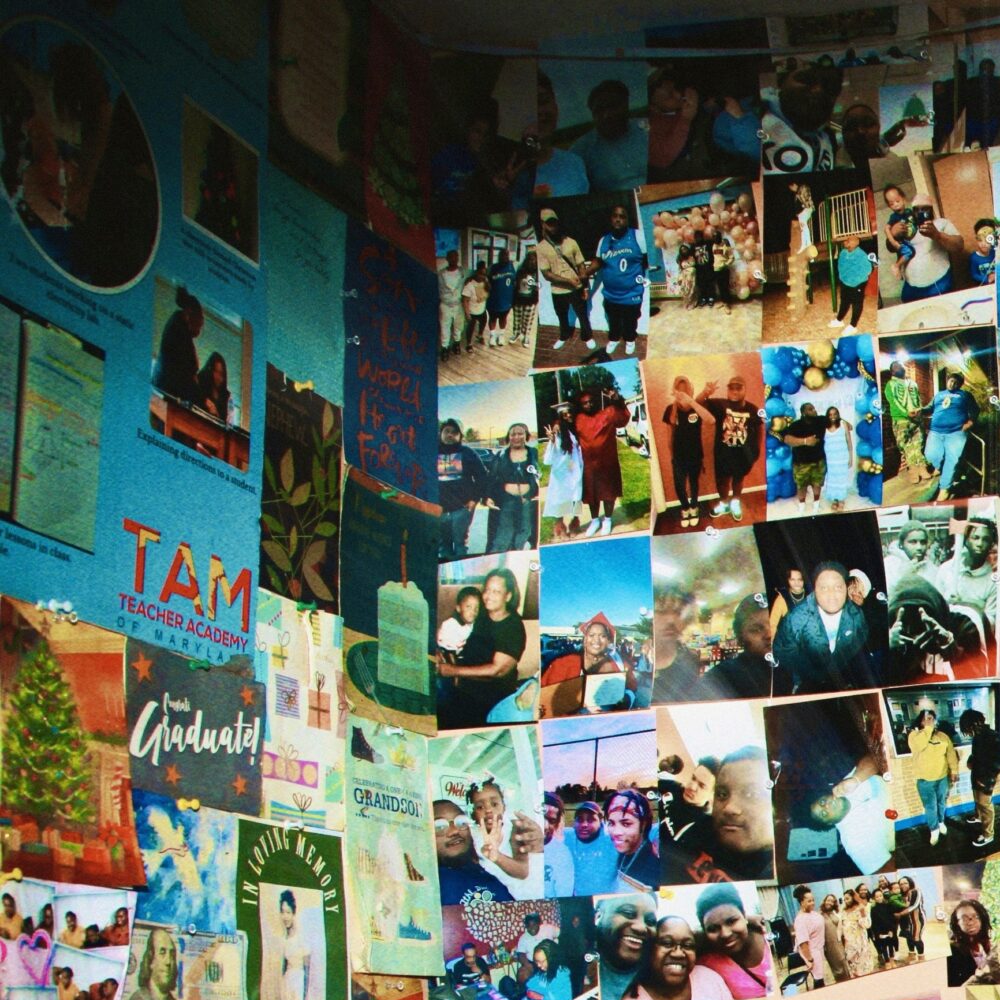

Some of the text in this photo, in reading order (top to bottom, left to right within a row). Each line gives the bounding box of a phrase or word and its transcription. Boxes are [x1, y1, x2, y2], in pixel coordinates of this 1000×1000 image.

[620, 258, 627, 272] 0
[137, 428, 179, 459] Explaining
[180, 450, 216, 475] directions
[122, 517, 252, 633] TAM
[117, 615, 140, 633] OF
[119, 593, 248, 653] TEACHER ACADEMY
[129, 700, 260, 767] Graduate!
[242, 827, 340, 914] IN LOVING MEMORY
